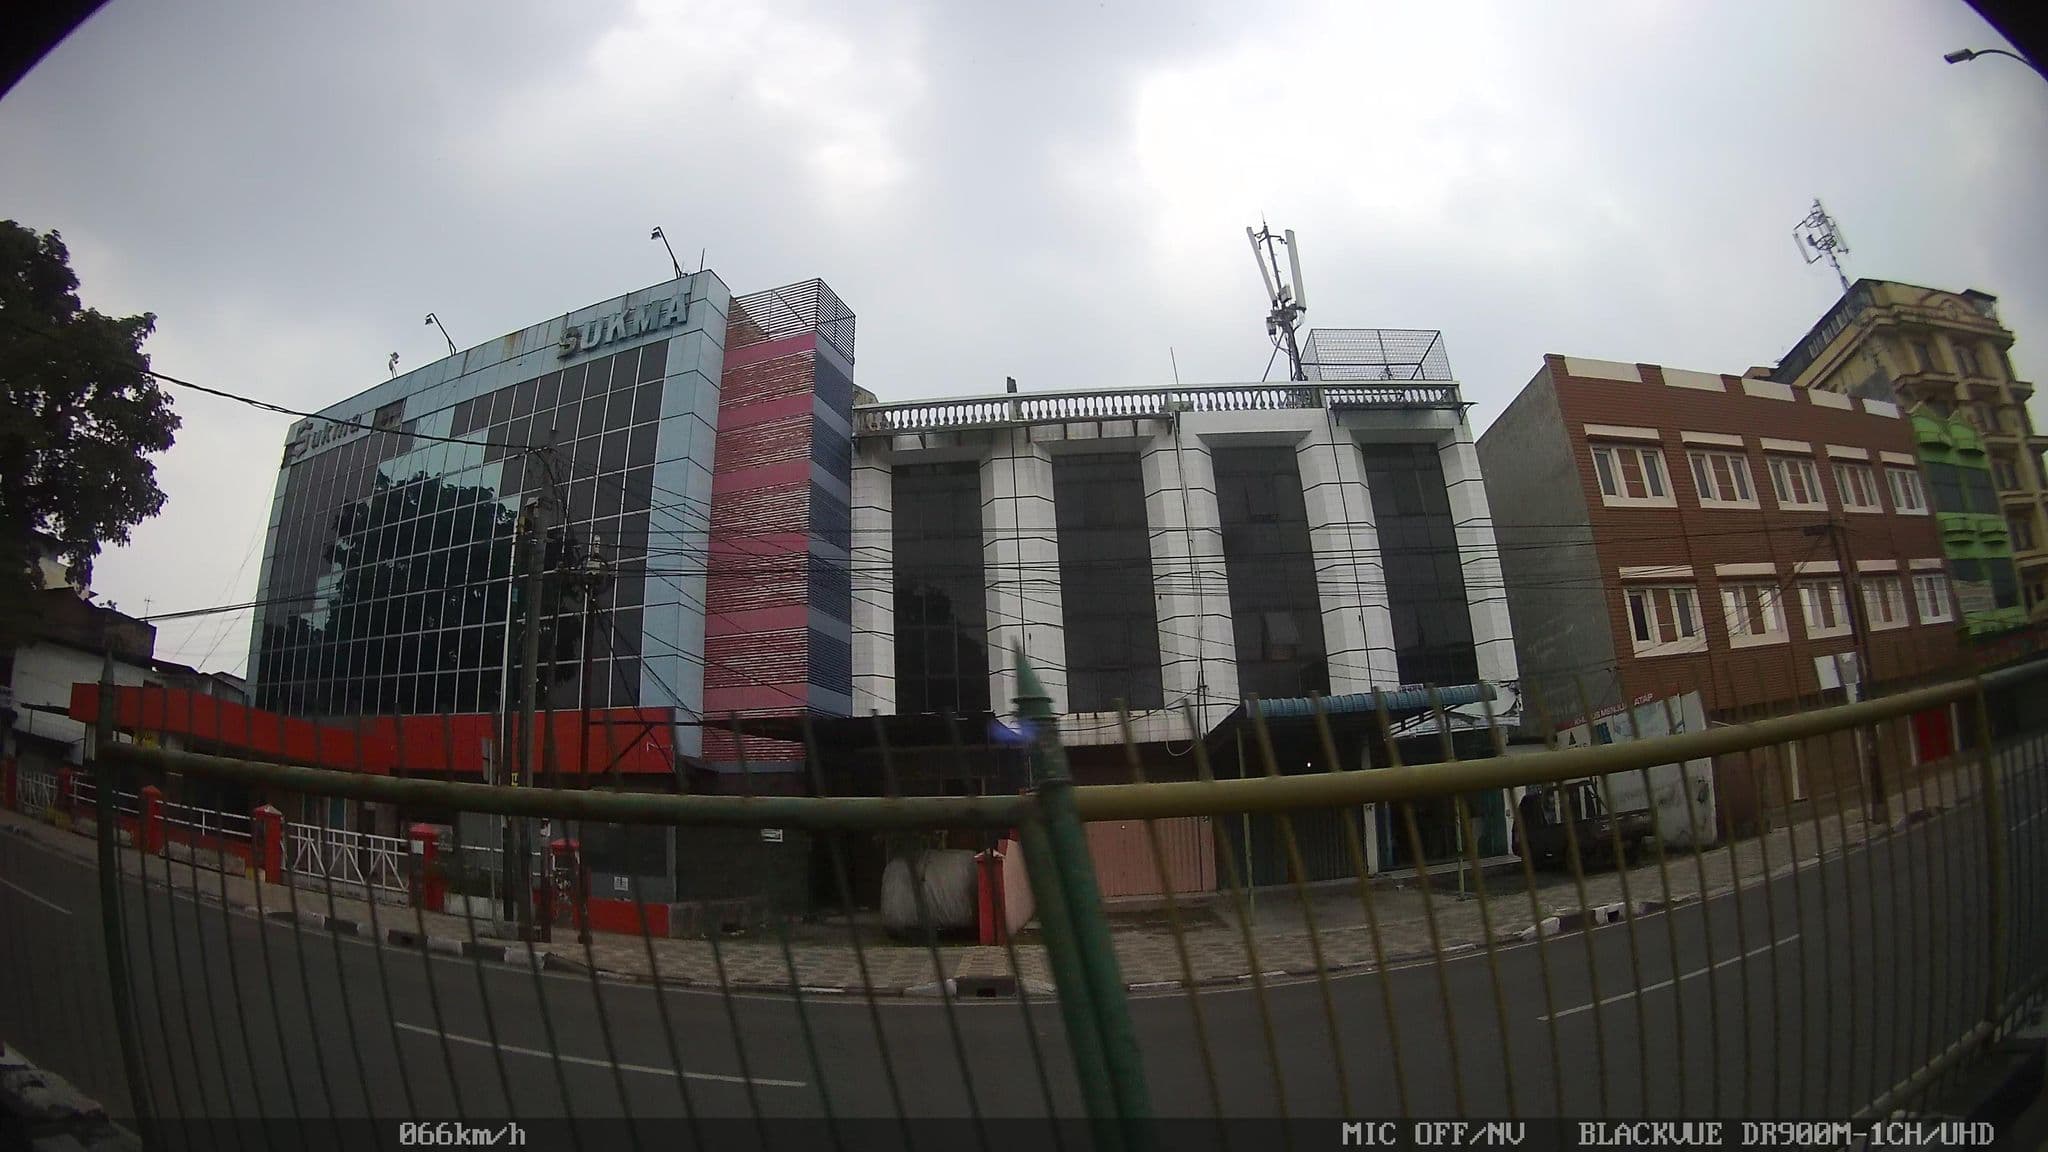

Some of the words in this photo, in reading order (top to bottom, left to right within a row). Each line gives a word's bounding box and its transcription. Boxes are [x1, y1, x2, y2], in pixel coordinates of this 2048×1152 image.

[557, 292, 691, 360] SUKMA
[288, 413, 362, 458] Sukma
[1633, 692, 1654, 706] ATAP
